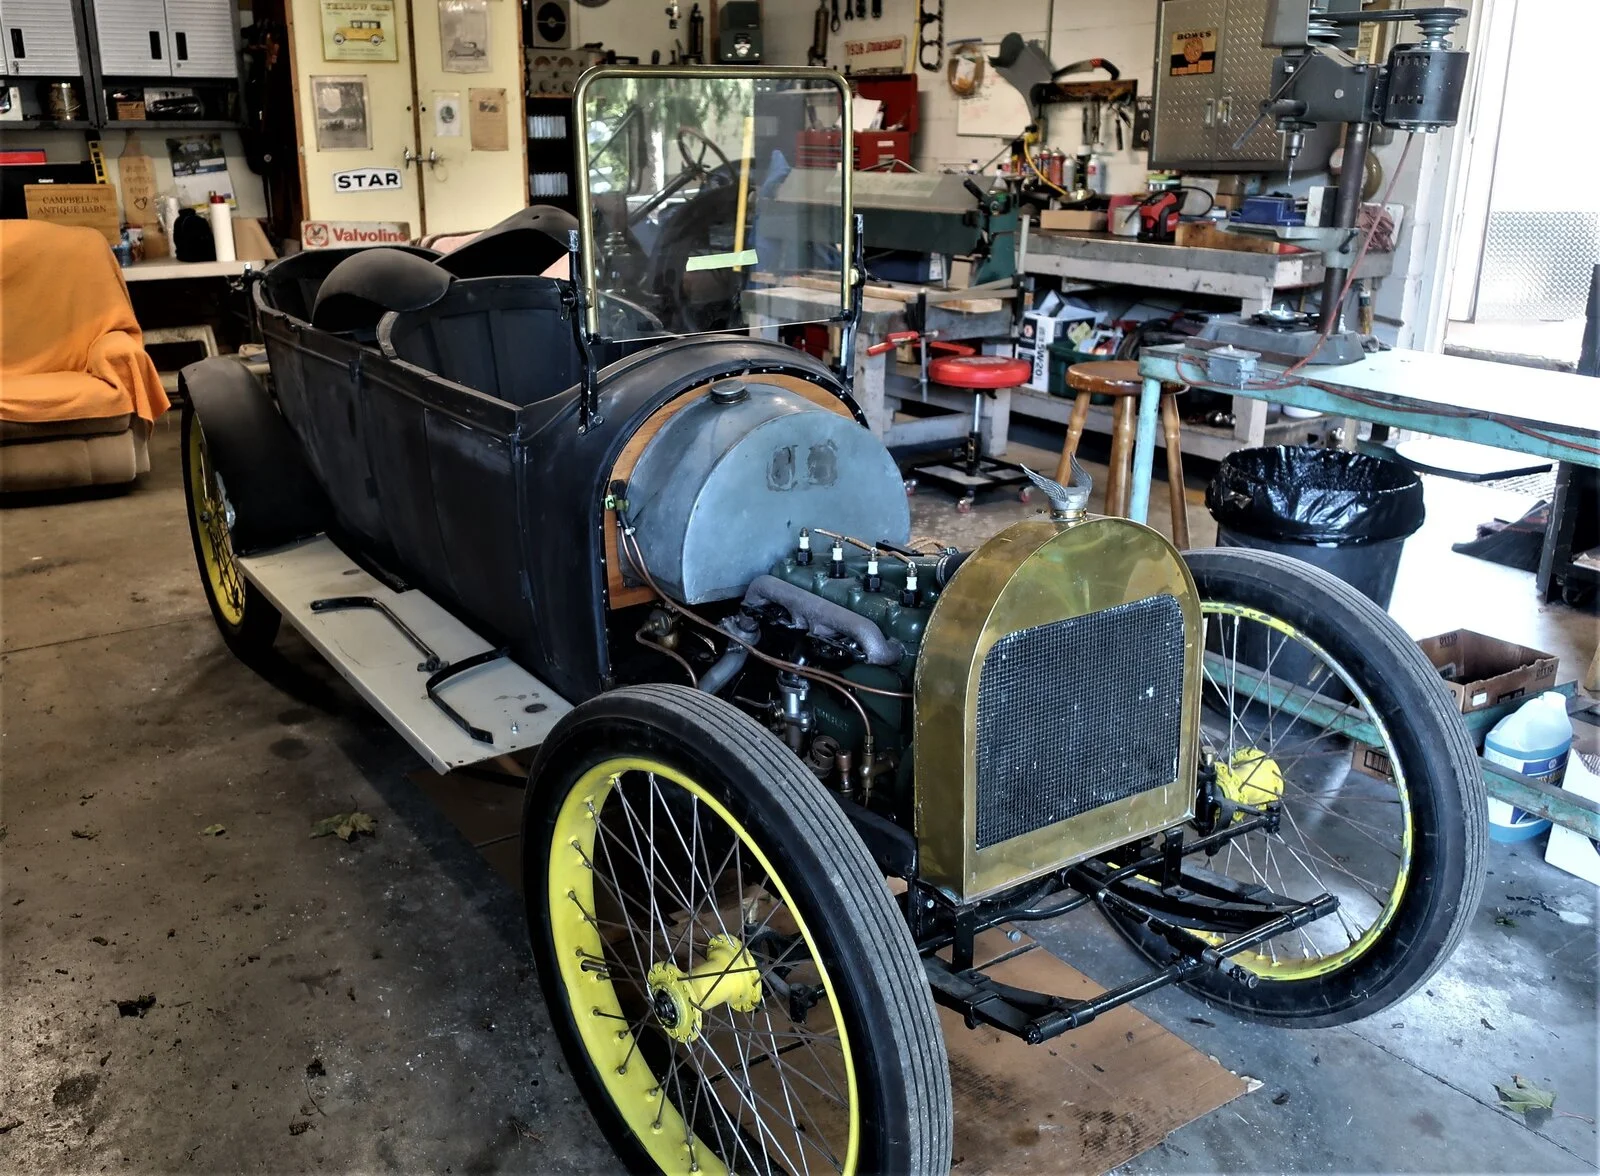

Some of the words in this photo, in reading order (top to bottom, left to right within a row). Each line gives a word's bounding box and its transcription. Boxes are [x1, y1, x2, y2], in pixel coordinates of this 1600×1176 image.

[337, 172, 399, 189] STAR
[42, 196, 100, 204] CAMPBELL'S
[37, 205, 80, 215] ANTIQUE
[81, 205, 107, 214] BARN
[332, 227, 409, 242] Valvoline
